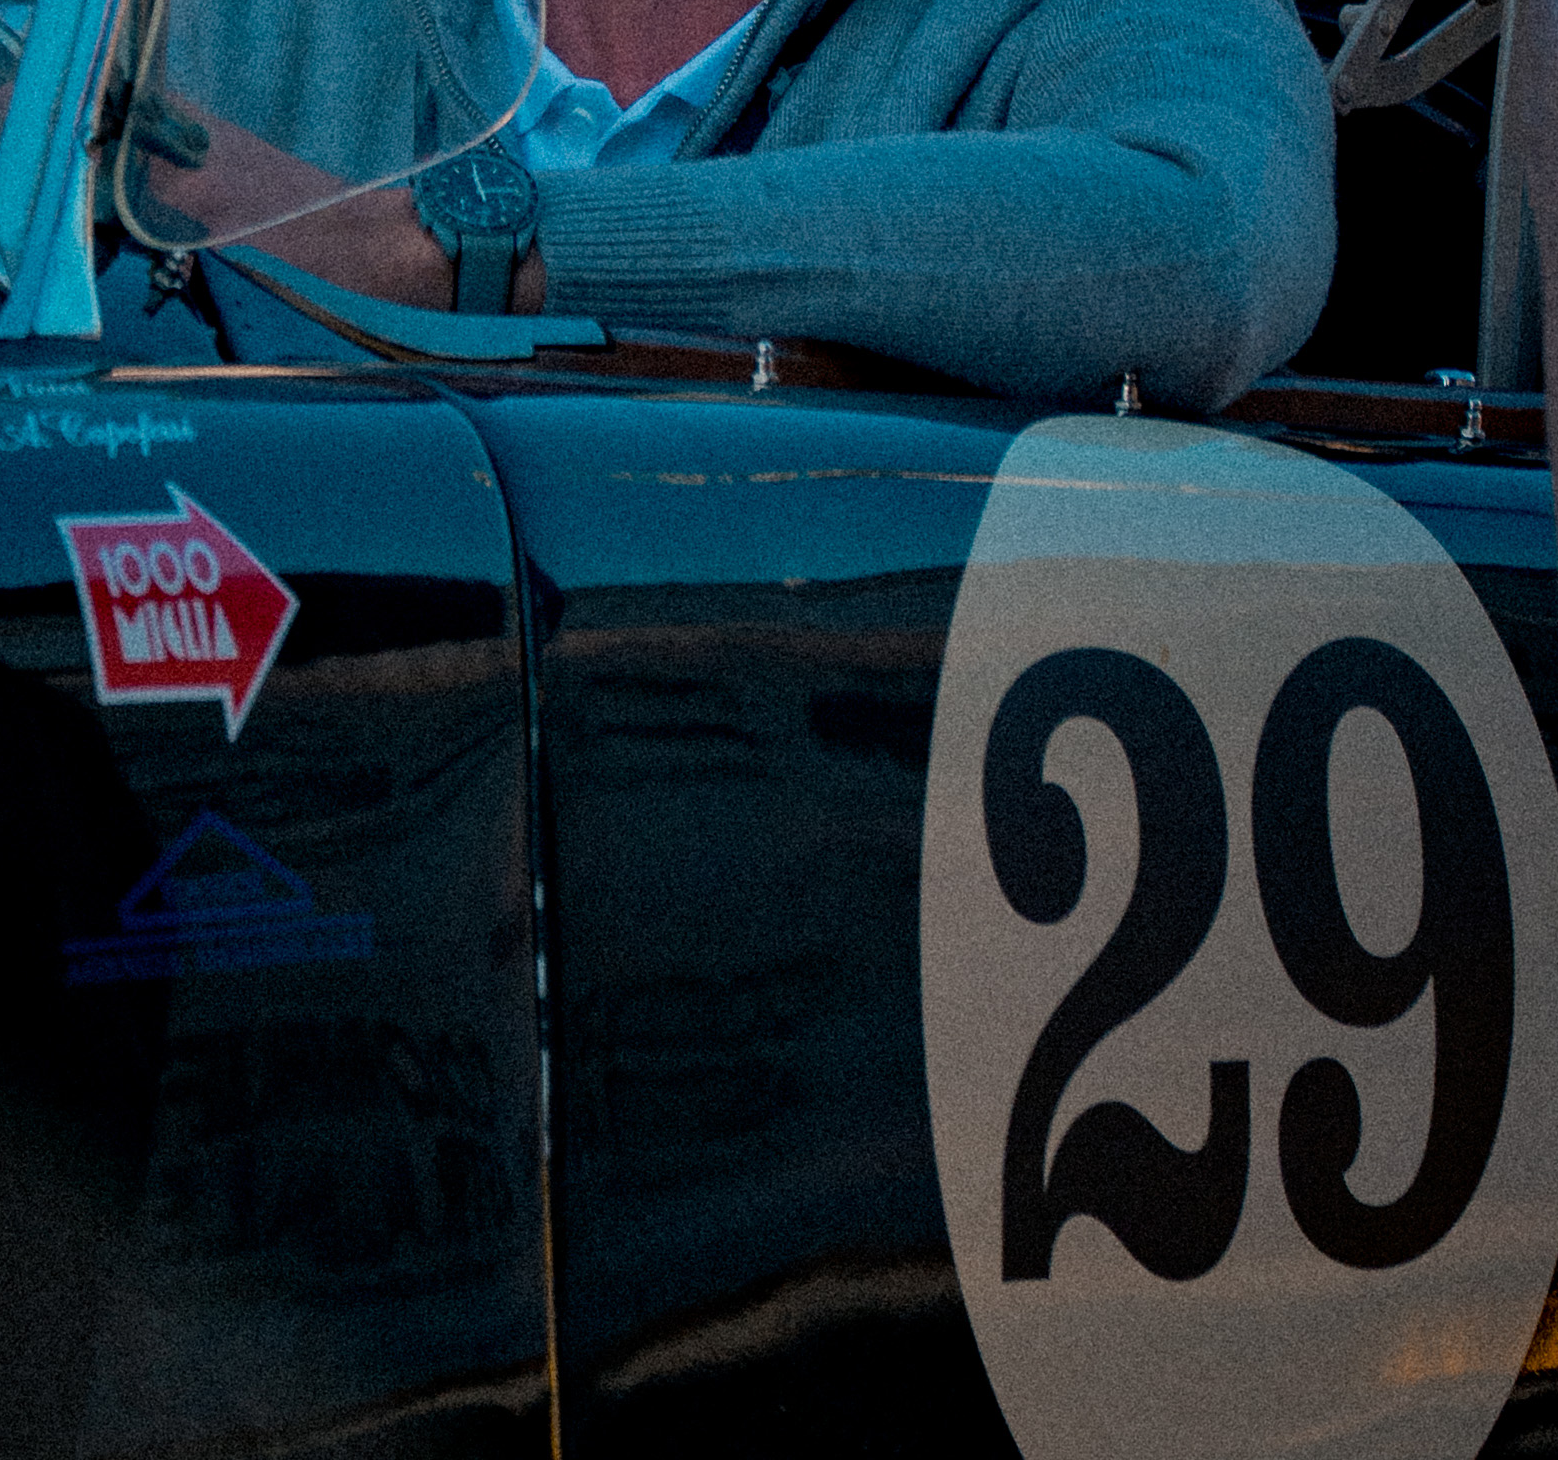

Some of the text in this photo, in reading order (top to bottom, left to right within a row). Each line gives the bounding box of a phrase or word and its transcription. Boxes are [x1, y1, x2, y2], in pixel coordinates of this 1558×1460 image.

[98, 538, 220, 599] 1000
[111, 597, 239, 665] MIGLIA
[982, 635, 1516, 1282] 29
